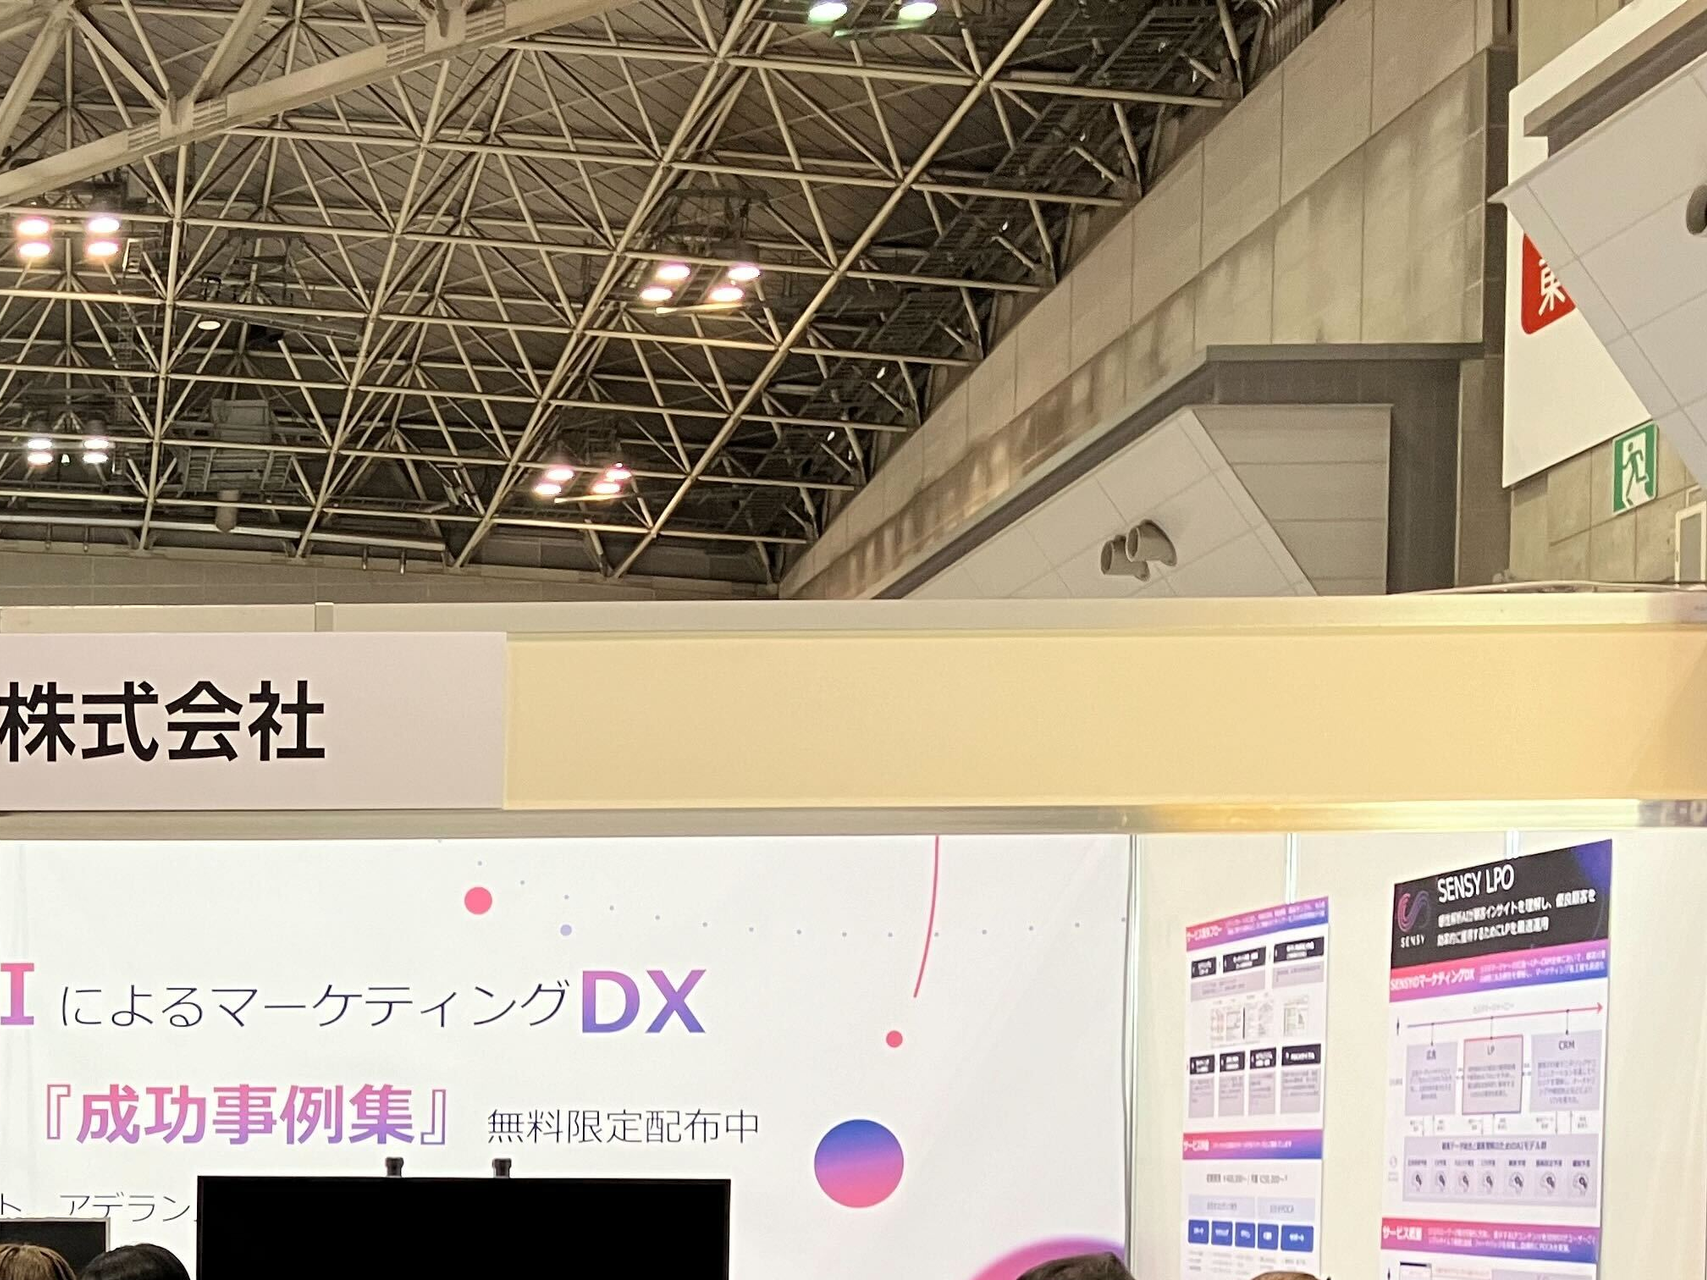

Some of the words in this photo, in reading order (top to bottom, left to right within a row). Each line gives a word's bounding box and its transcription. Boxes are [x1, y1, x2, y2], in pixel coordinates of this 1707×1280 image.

[1437, 870, 1482, 903] SENSY
[1486, 863, 1515, 894] LPO
[1400, 934, 1425, 949] SENSY
[61, 969, 706, 1035] によるマーケティングDX
[47, 1084, 447, 1146] 『成功事例集』
[488, 1109, 760, 1145] 無料限定配布中
